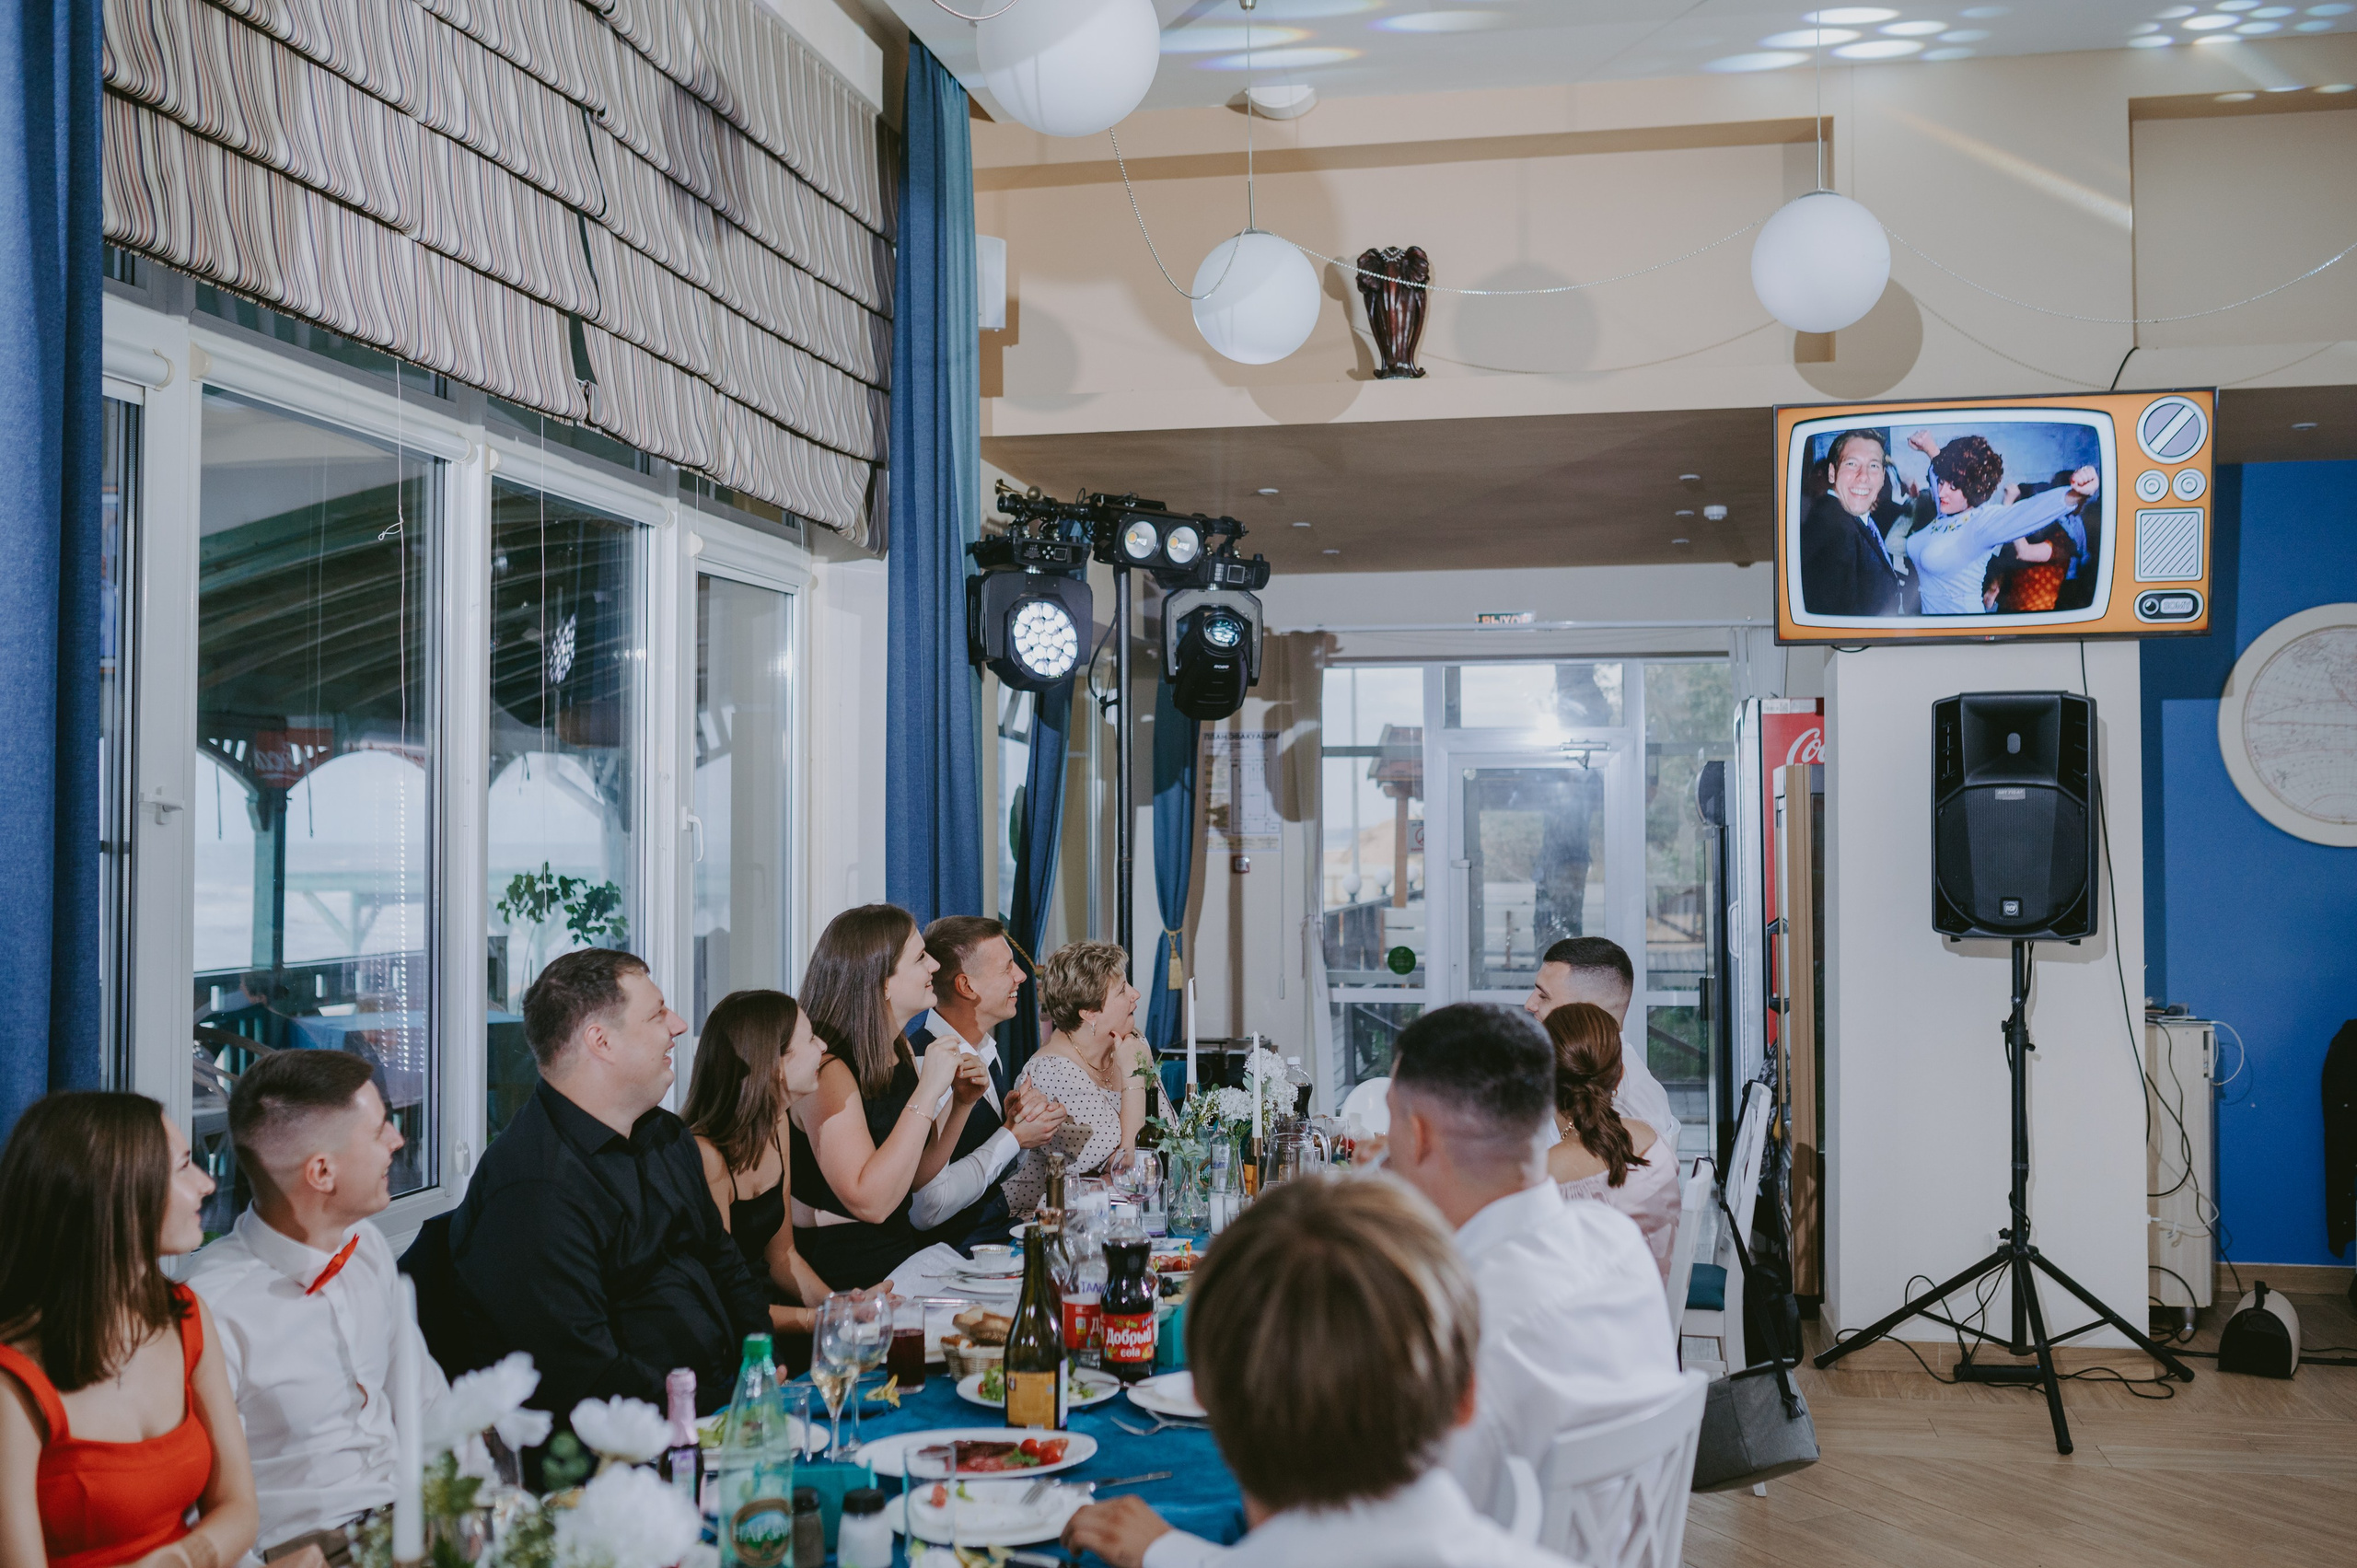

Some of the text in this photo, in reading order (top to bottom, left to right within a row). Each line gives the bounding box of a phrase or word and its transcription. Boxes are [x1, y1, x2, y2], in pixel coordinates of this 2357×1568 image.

[1203, 731, 1280, 740] ПЛАН ЭВАКУАЦИИ
[1106, 1325, 1153, 1348] Добрый
[1120, 1347, 1141, 1358] cola
